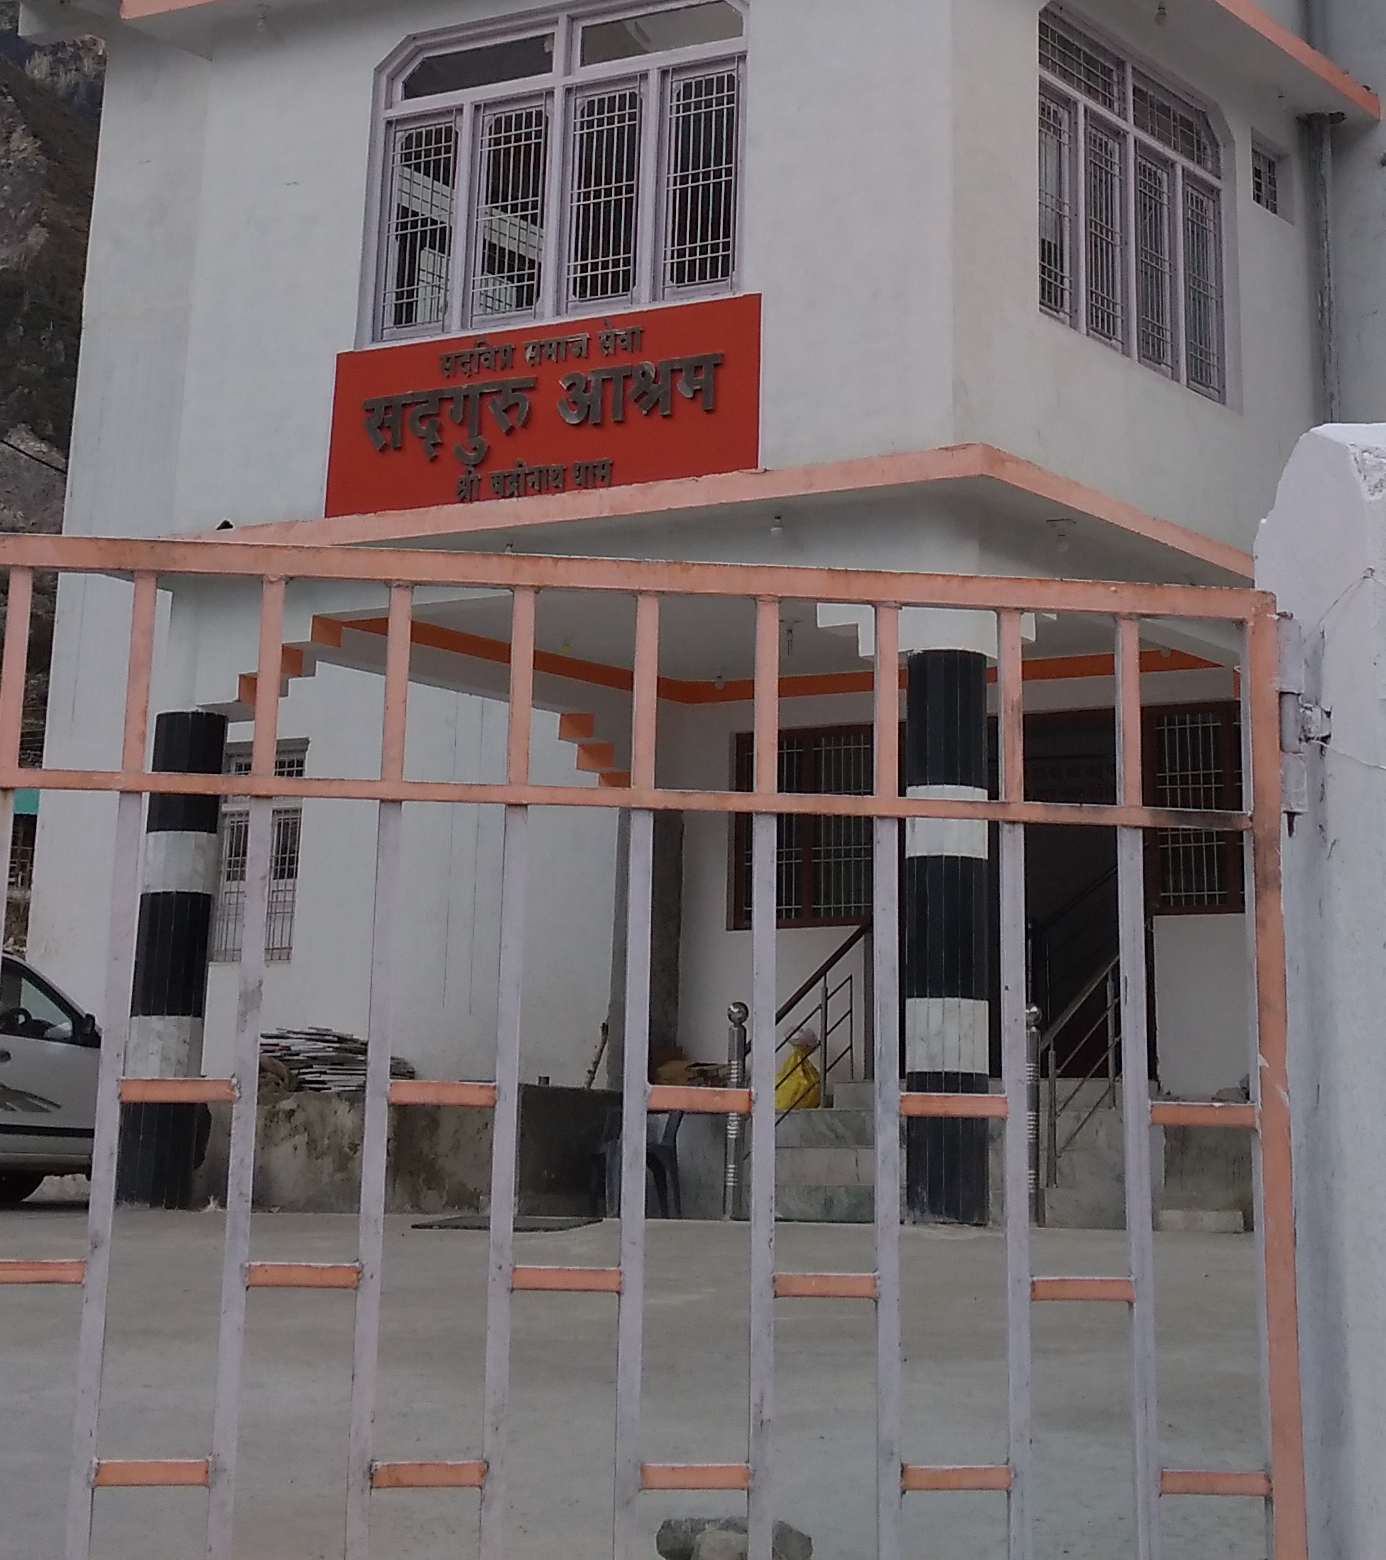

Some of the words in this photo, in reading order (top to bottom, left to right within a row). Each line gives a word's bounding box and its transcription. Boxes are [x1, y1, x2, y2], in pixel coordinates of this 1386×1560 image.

[523, 333, 590, 367] समाज
[596, 318, 645, 357] सेवा
[362, 376, 537, 465] सद्गुरु
[557, 351, 725, 425] आश्रम
[456, 464, 482, 502] श्री
[488, 458, 567, 498] बद्रीनाथ
[572, 458, 614, 489] धाम
